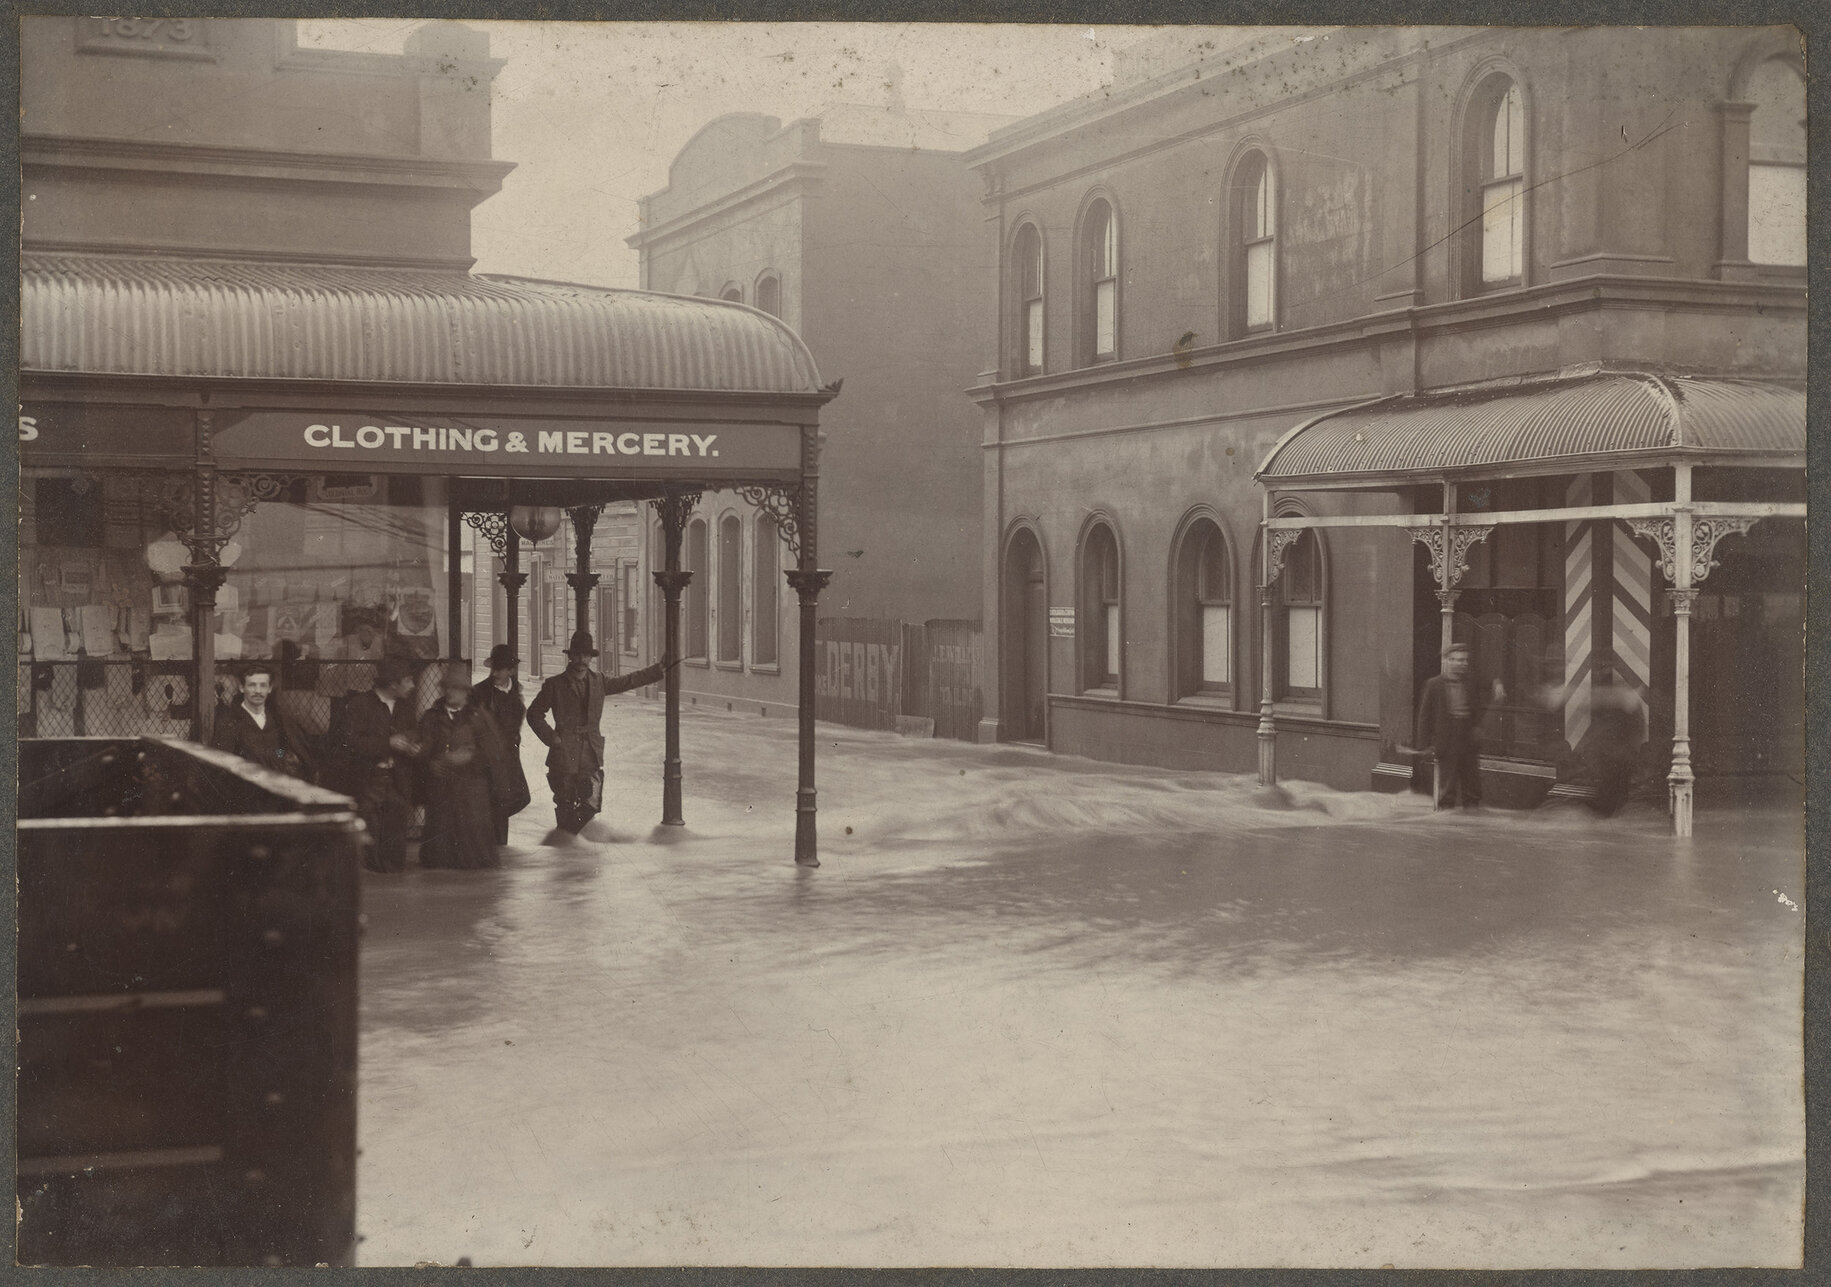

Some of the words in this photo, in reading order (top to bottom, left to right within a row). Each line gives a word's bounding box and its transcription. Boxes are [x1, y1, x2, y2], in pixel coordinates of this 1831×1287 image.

[304, 424, 499, 452] CLOTHING
[505, 431, 529, 454] &
[538, 430, 719, 457] MERCERY.
